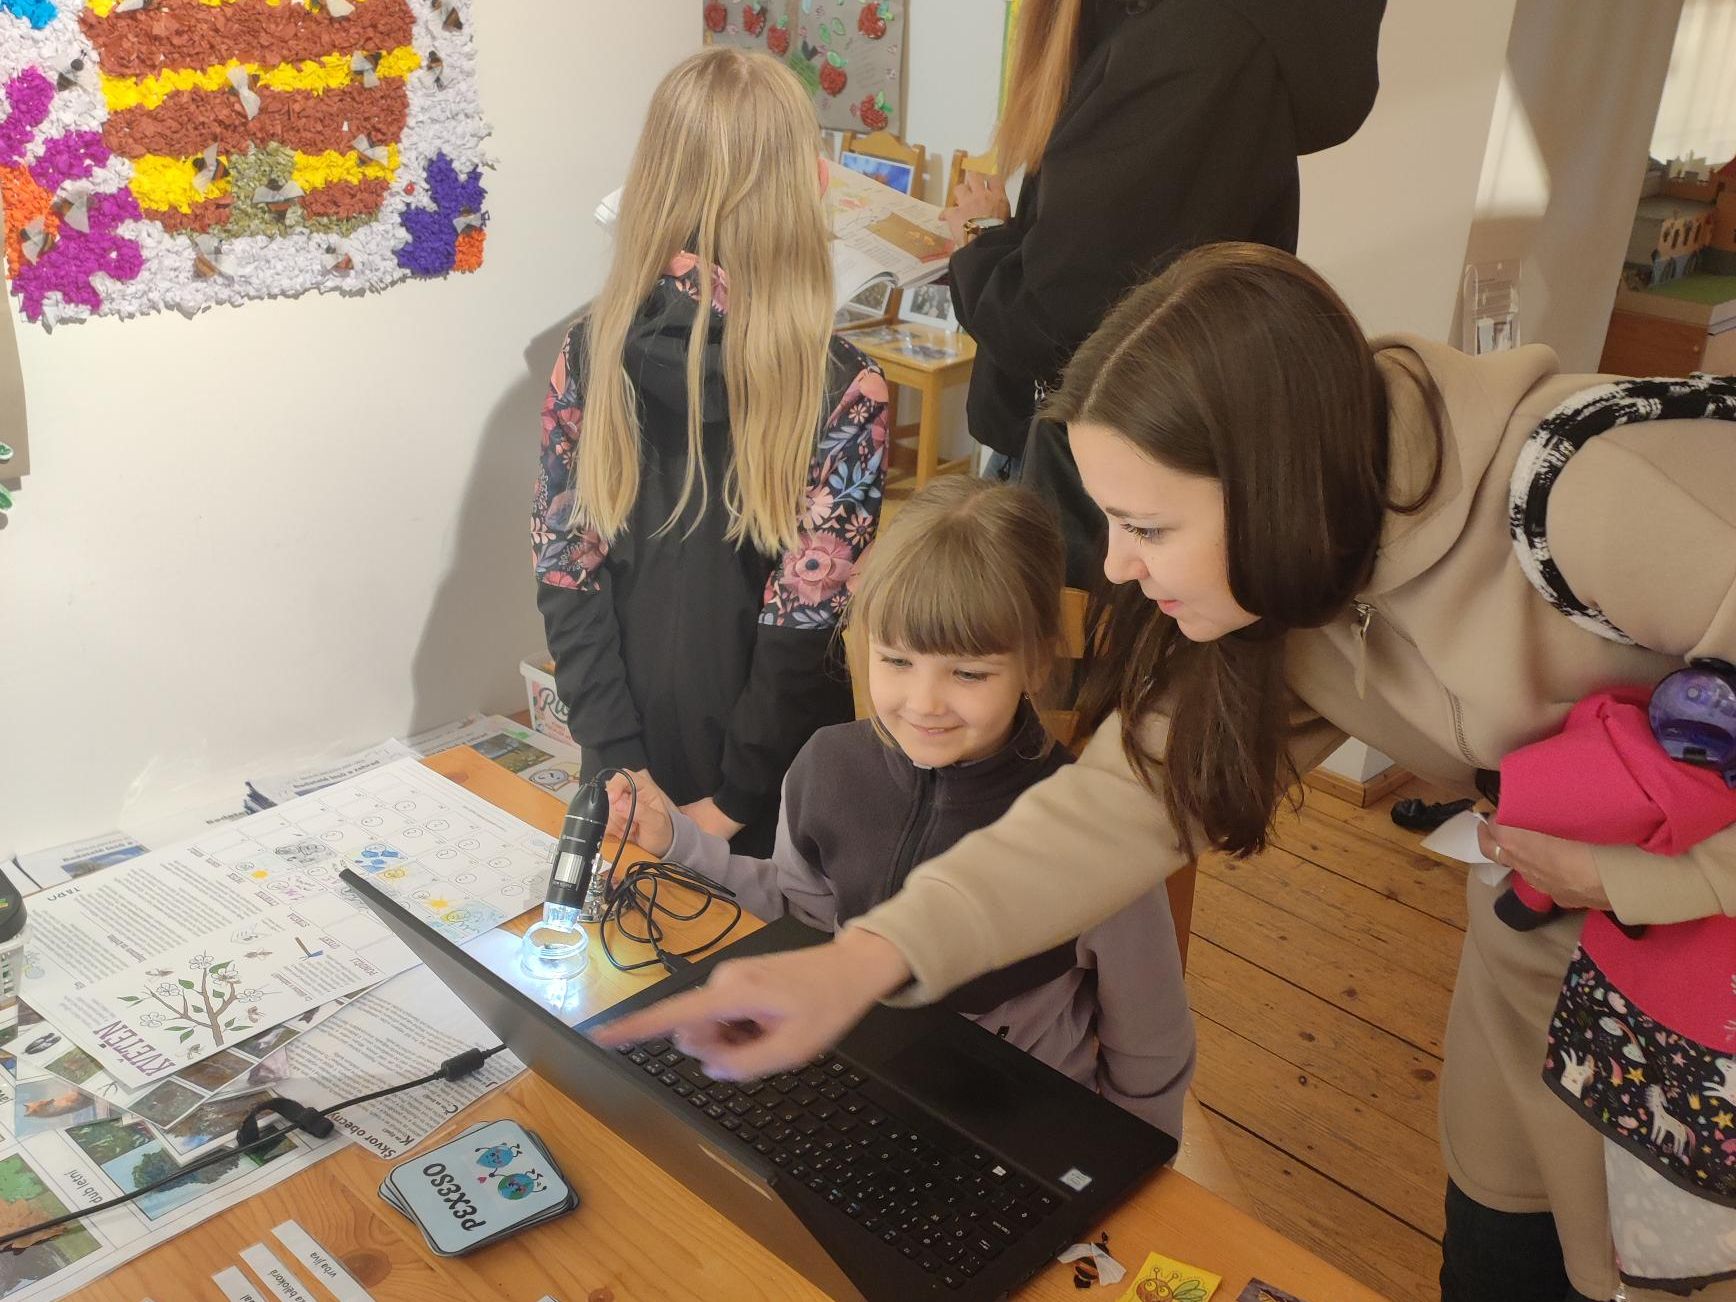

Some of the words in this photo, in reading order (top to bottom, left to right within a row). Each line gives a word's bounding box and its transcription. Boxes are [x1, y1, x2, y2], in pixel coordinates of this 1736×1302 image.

[63, 1169, 89, 1190] letní
[82, 1187, 103, 1204] dub
[422, 1163, 487, 1231] PEXESO
[320, 1262, 337, 1279] vrba
